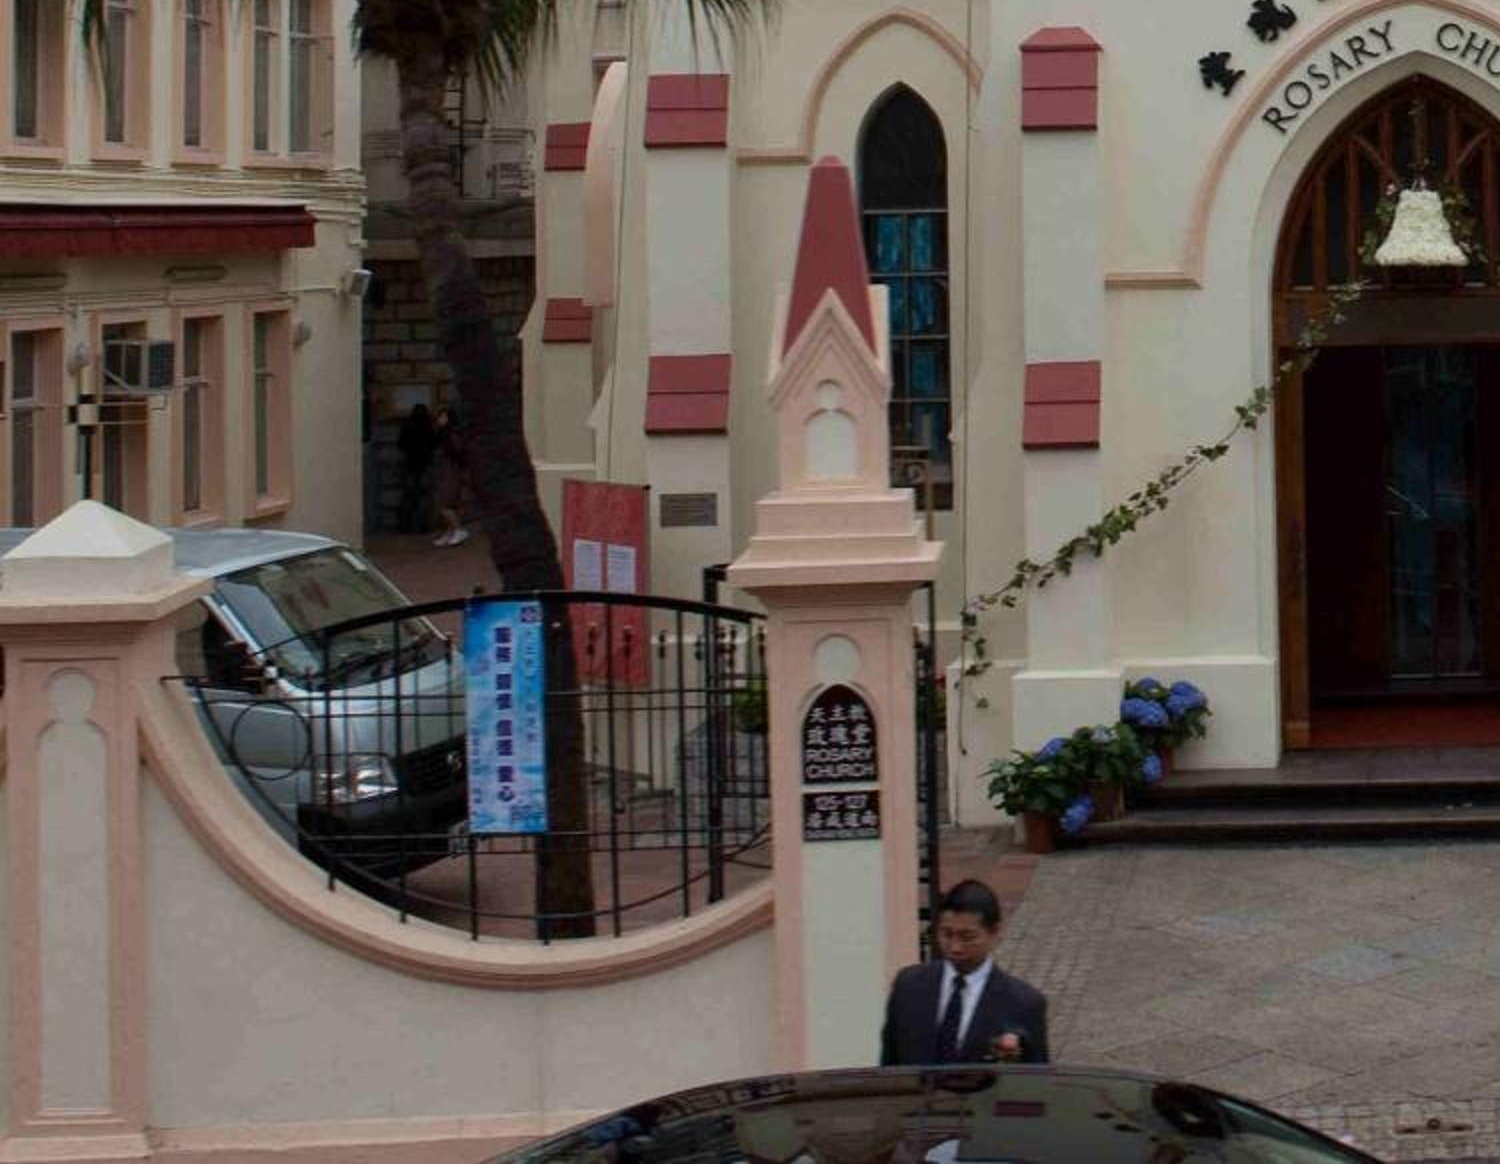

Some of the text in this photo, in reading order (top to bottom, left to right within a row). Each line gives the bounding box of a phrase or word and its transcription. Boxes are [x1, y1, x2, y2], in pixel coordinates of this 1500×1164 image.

[1262, 20, 1397, 134] ROSARY
[806, 747, 873, 762] ROSARY
[806, 763, 874, 779] CHURCH
